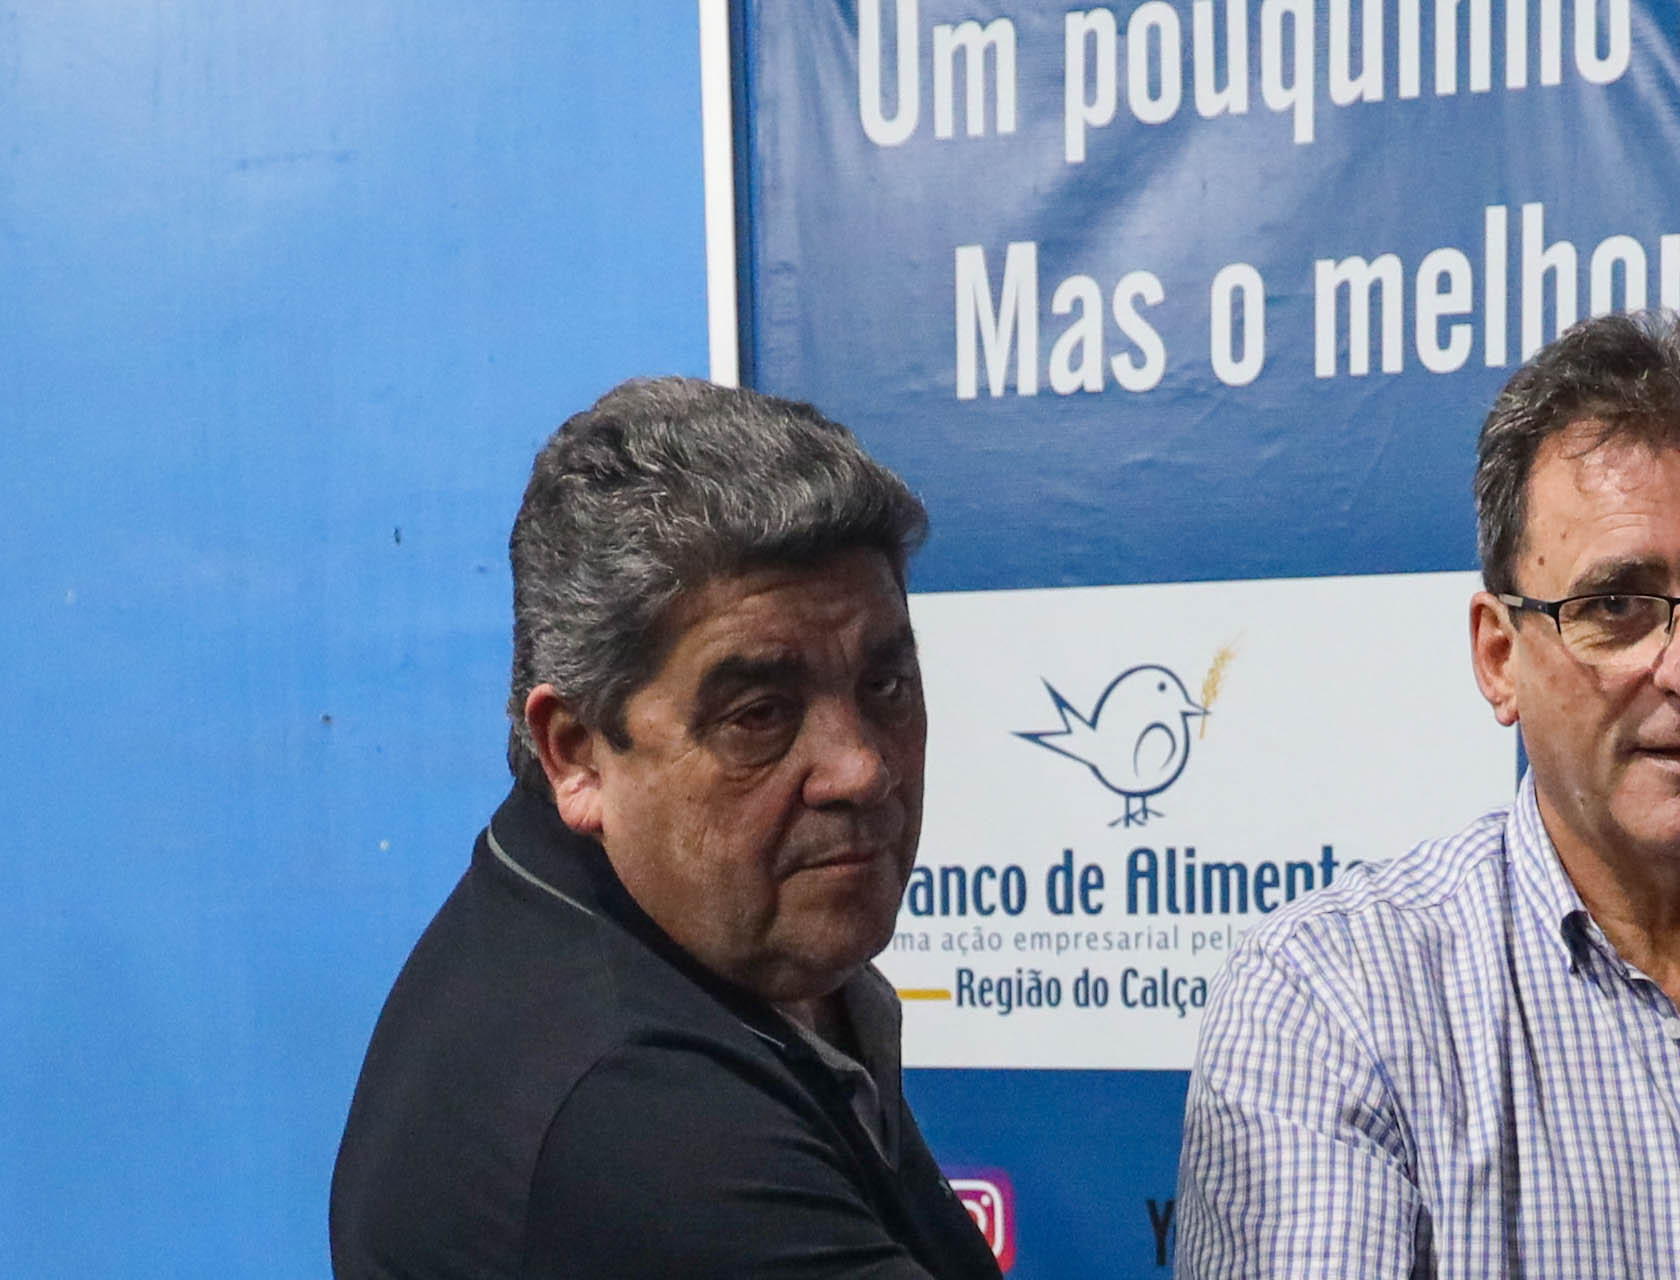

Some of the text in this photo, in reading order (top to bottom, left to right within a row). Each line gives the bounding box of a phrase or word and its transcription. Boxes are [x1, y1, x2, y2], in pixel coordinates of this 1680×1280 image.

[858, 0, 1016, 148] Um
[1064, 0, 1631, 163] pouquinho
[955, 242, 1167, 399] Mas
[1210, 263, 1266, 386] o
[897, 844, 1370, 917] anco de Aliment
[941, 920, 1003, 957] ação
[1014, 919, 1180, 959] empresarial
[956, 967, 1062, 1017] Região
[1073, 967, 1109, 1008] do
